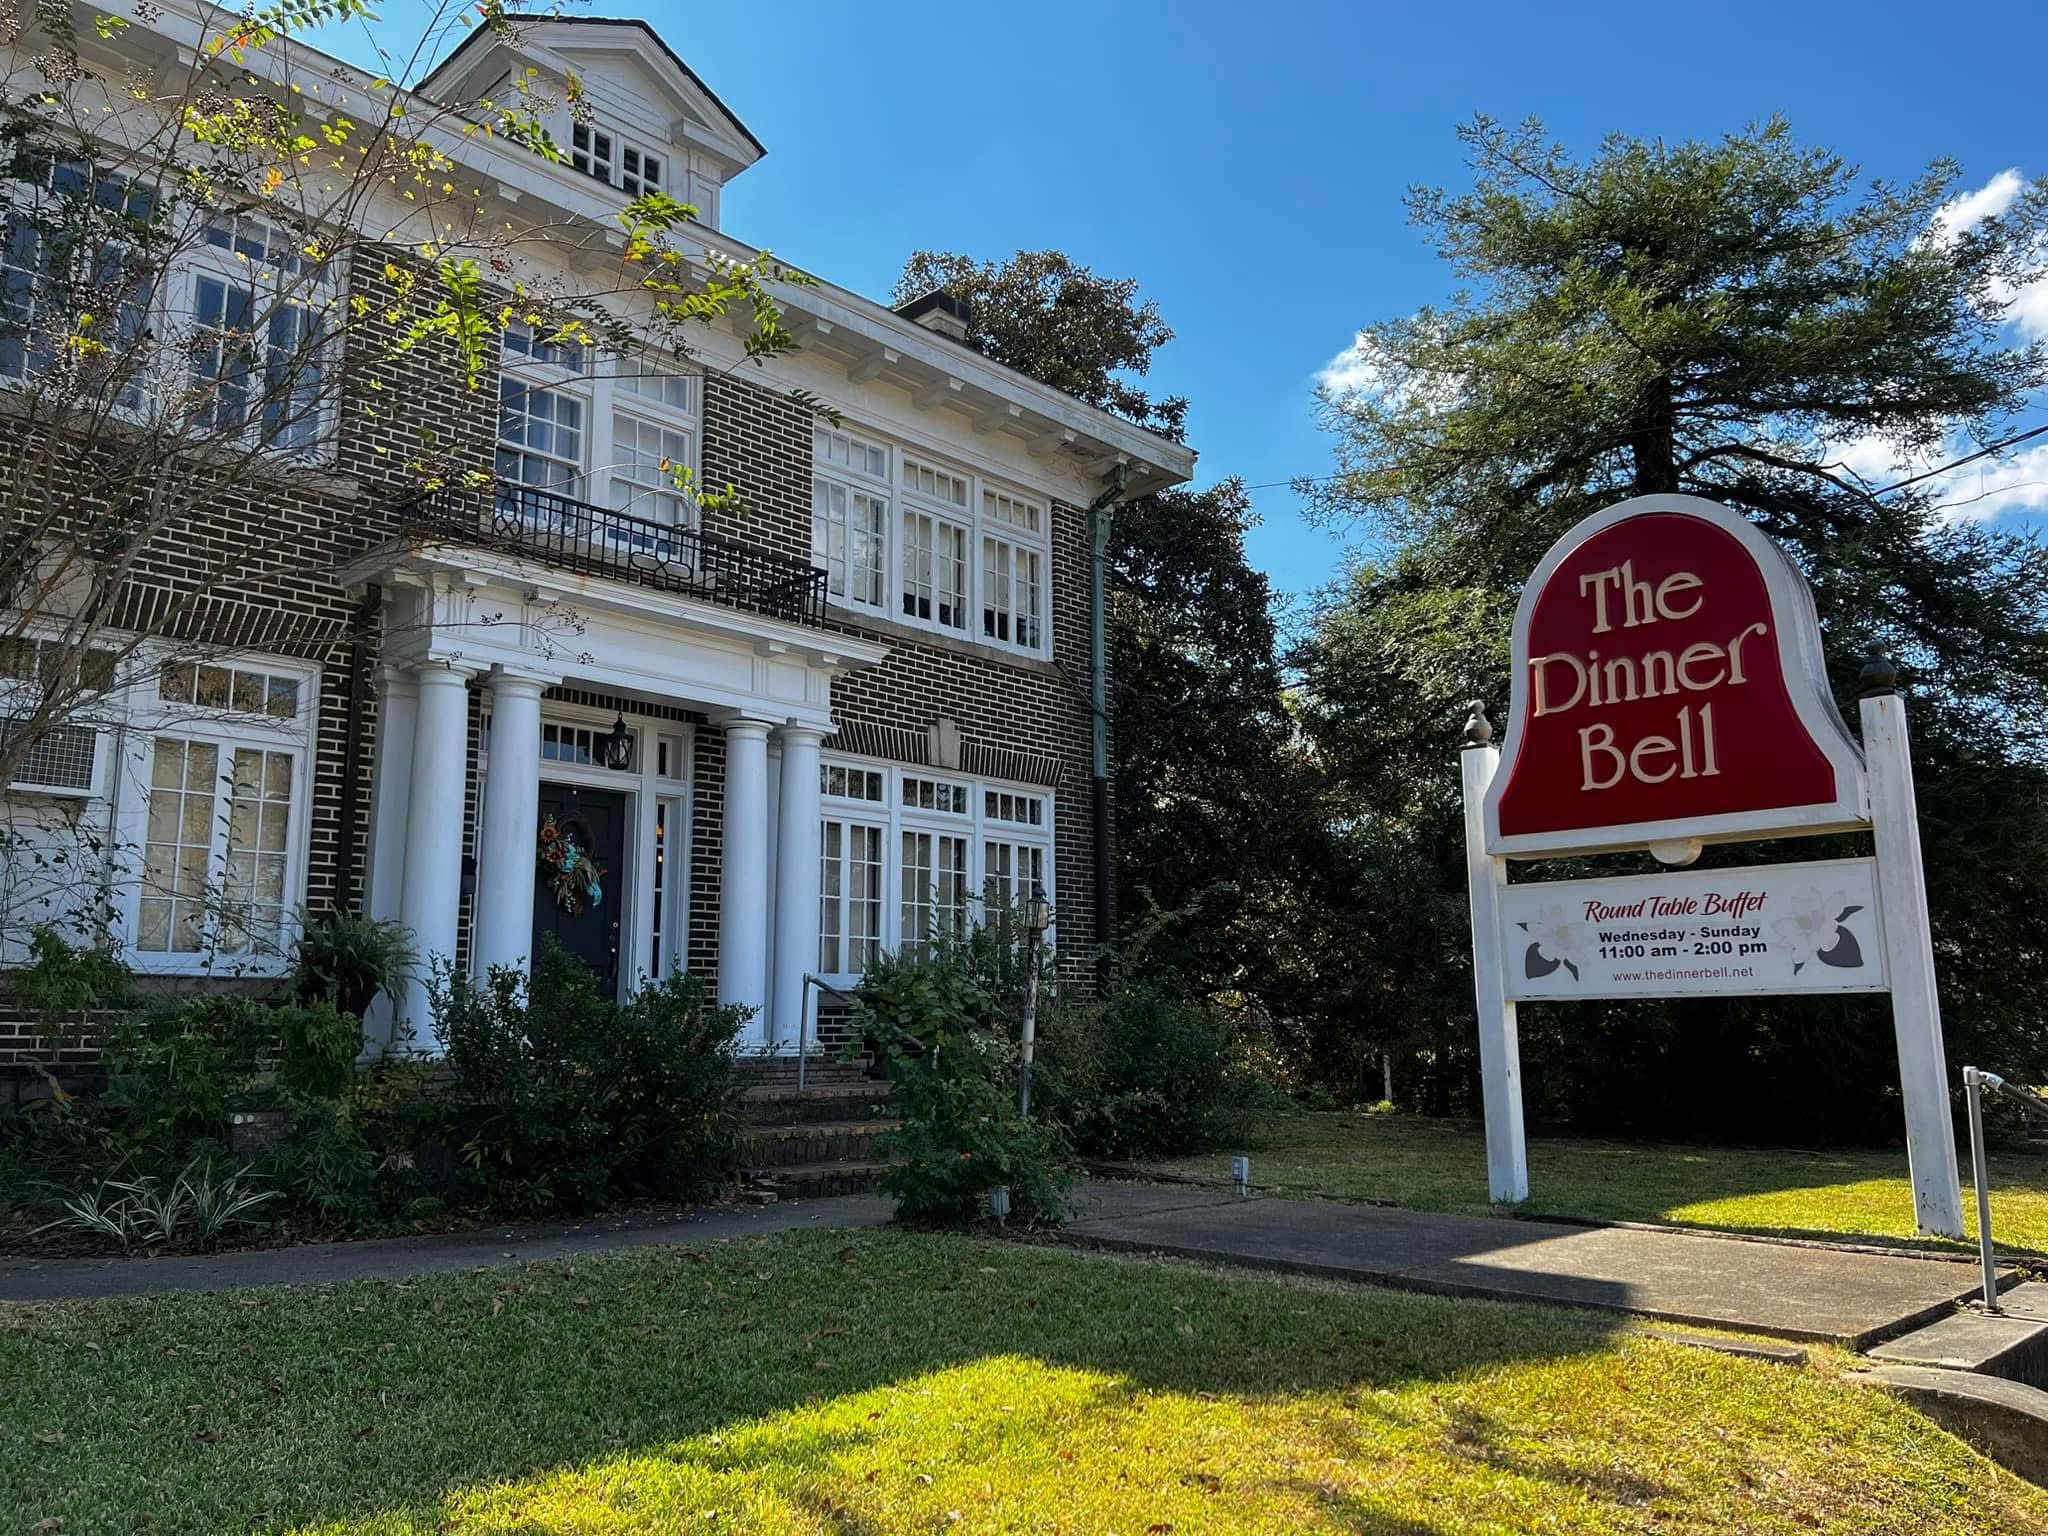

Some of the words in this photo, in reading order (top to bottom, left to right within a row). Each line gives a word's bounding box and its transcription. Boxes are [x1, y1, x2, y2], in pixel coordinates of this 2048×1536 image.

[1579, 559, 1703, 634] The
[1529, 622, 1767, 718] Dinner
[1578, 702, 1720, 792] Bell
[1583, 900, 1646, 922] Round
[1648, 896, 1697, 918] Table
[1700, 892, 1768, 919] Buffet
[1599, 930, 1686, 943] Wednesday
[1701, 925, 1760, 939] Sunday
[1599, 945, 1645, 959] 11:00
[1651, 946, 1677, 957] am
[1694, 941, 1732, 955] 2:00
[1739, 942, 1767, 956] pm
[1613, 967, 1754, 982] www.thedinnerbell.net
